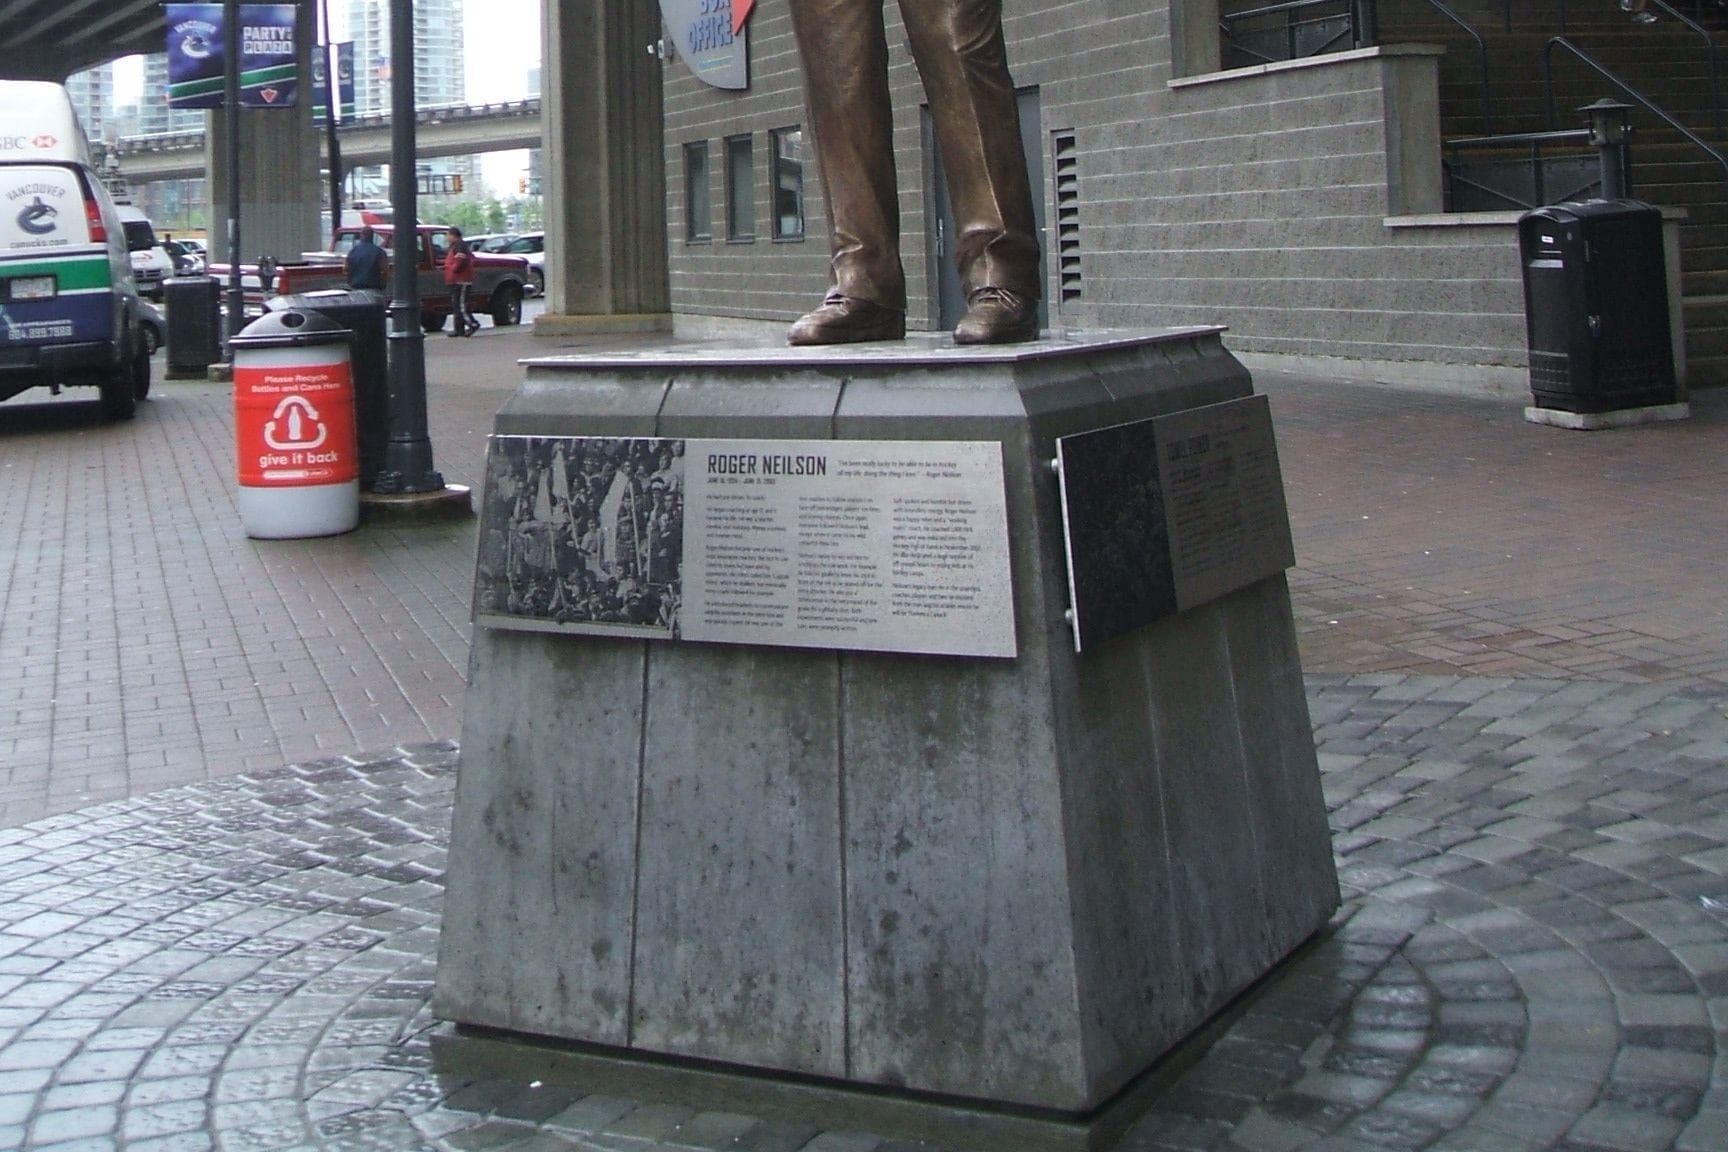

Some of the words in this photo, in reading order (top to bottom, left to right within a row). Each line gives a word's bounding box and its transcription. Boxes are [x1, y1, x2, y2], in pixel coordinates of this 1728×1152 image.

[243, 27, 285, 40] PARTY
[688, 14, 734, 54] OFFICE
[243, 41, 293, 54] PLAZA
[5, 183, 65, 200] VANCOUVER
[259, 453, 288, 468] give
[292, 452, 303, 464] it
[307, 450, 338, 464] back
[708, 455, 757, 474] ROGER
[763, 455, 827, 476] NEILSON
